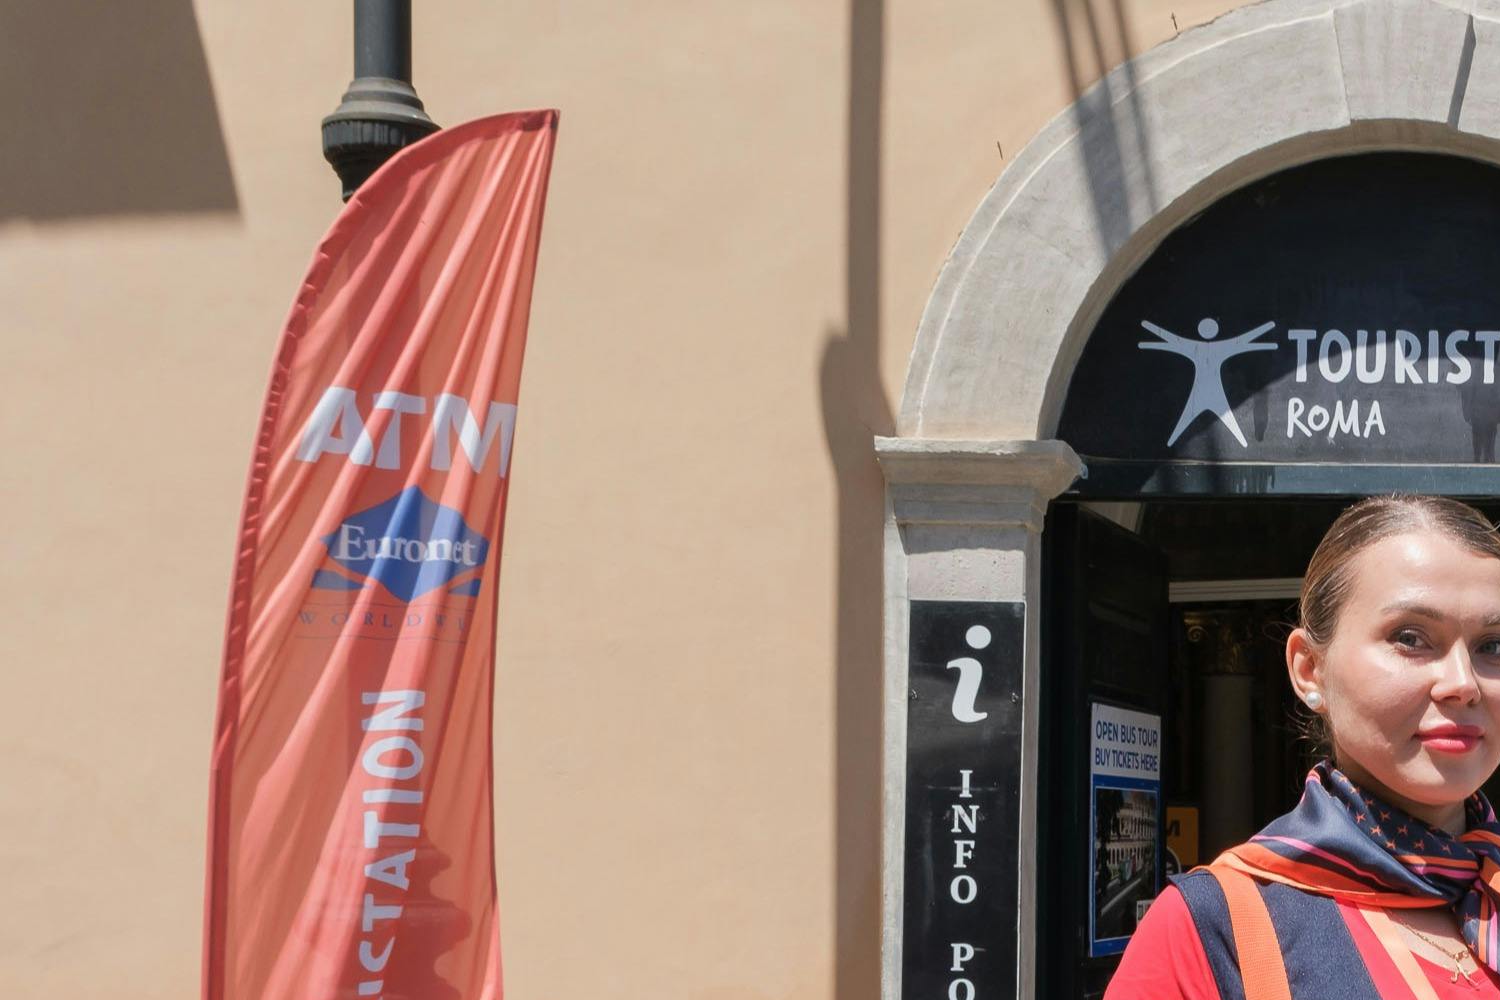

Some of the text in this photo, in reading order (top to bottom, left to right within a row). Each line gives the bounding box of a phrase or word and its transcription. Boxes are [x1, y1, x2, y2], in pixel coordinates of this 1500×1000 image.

[295, 386, 518, 479] ATM
[334, 523, 477, 566] Euronet
[1095, 720, 1158, 748] OPEN BUS TOUR
[1095, 747, 1158, 772] BUY TICKETS HERE
[950, 769, 980, 904] INFO
